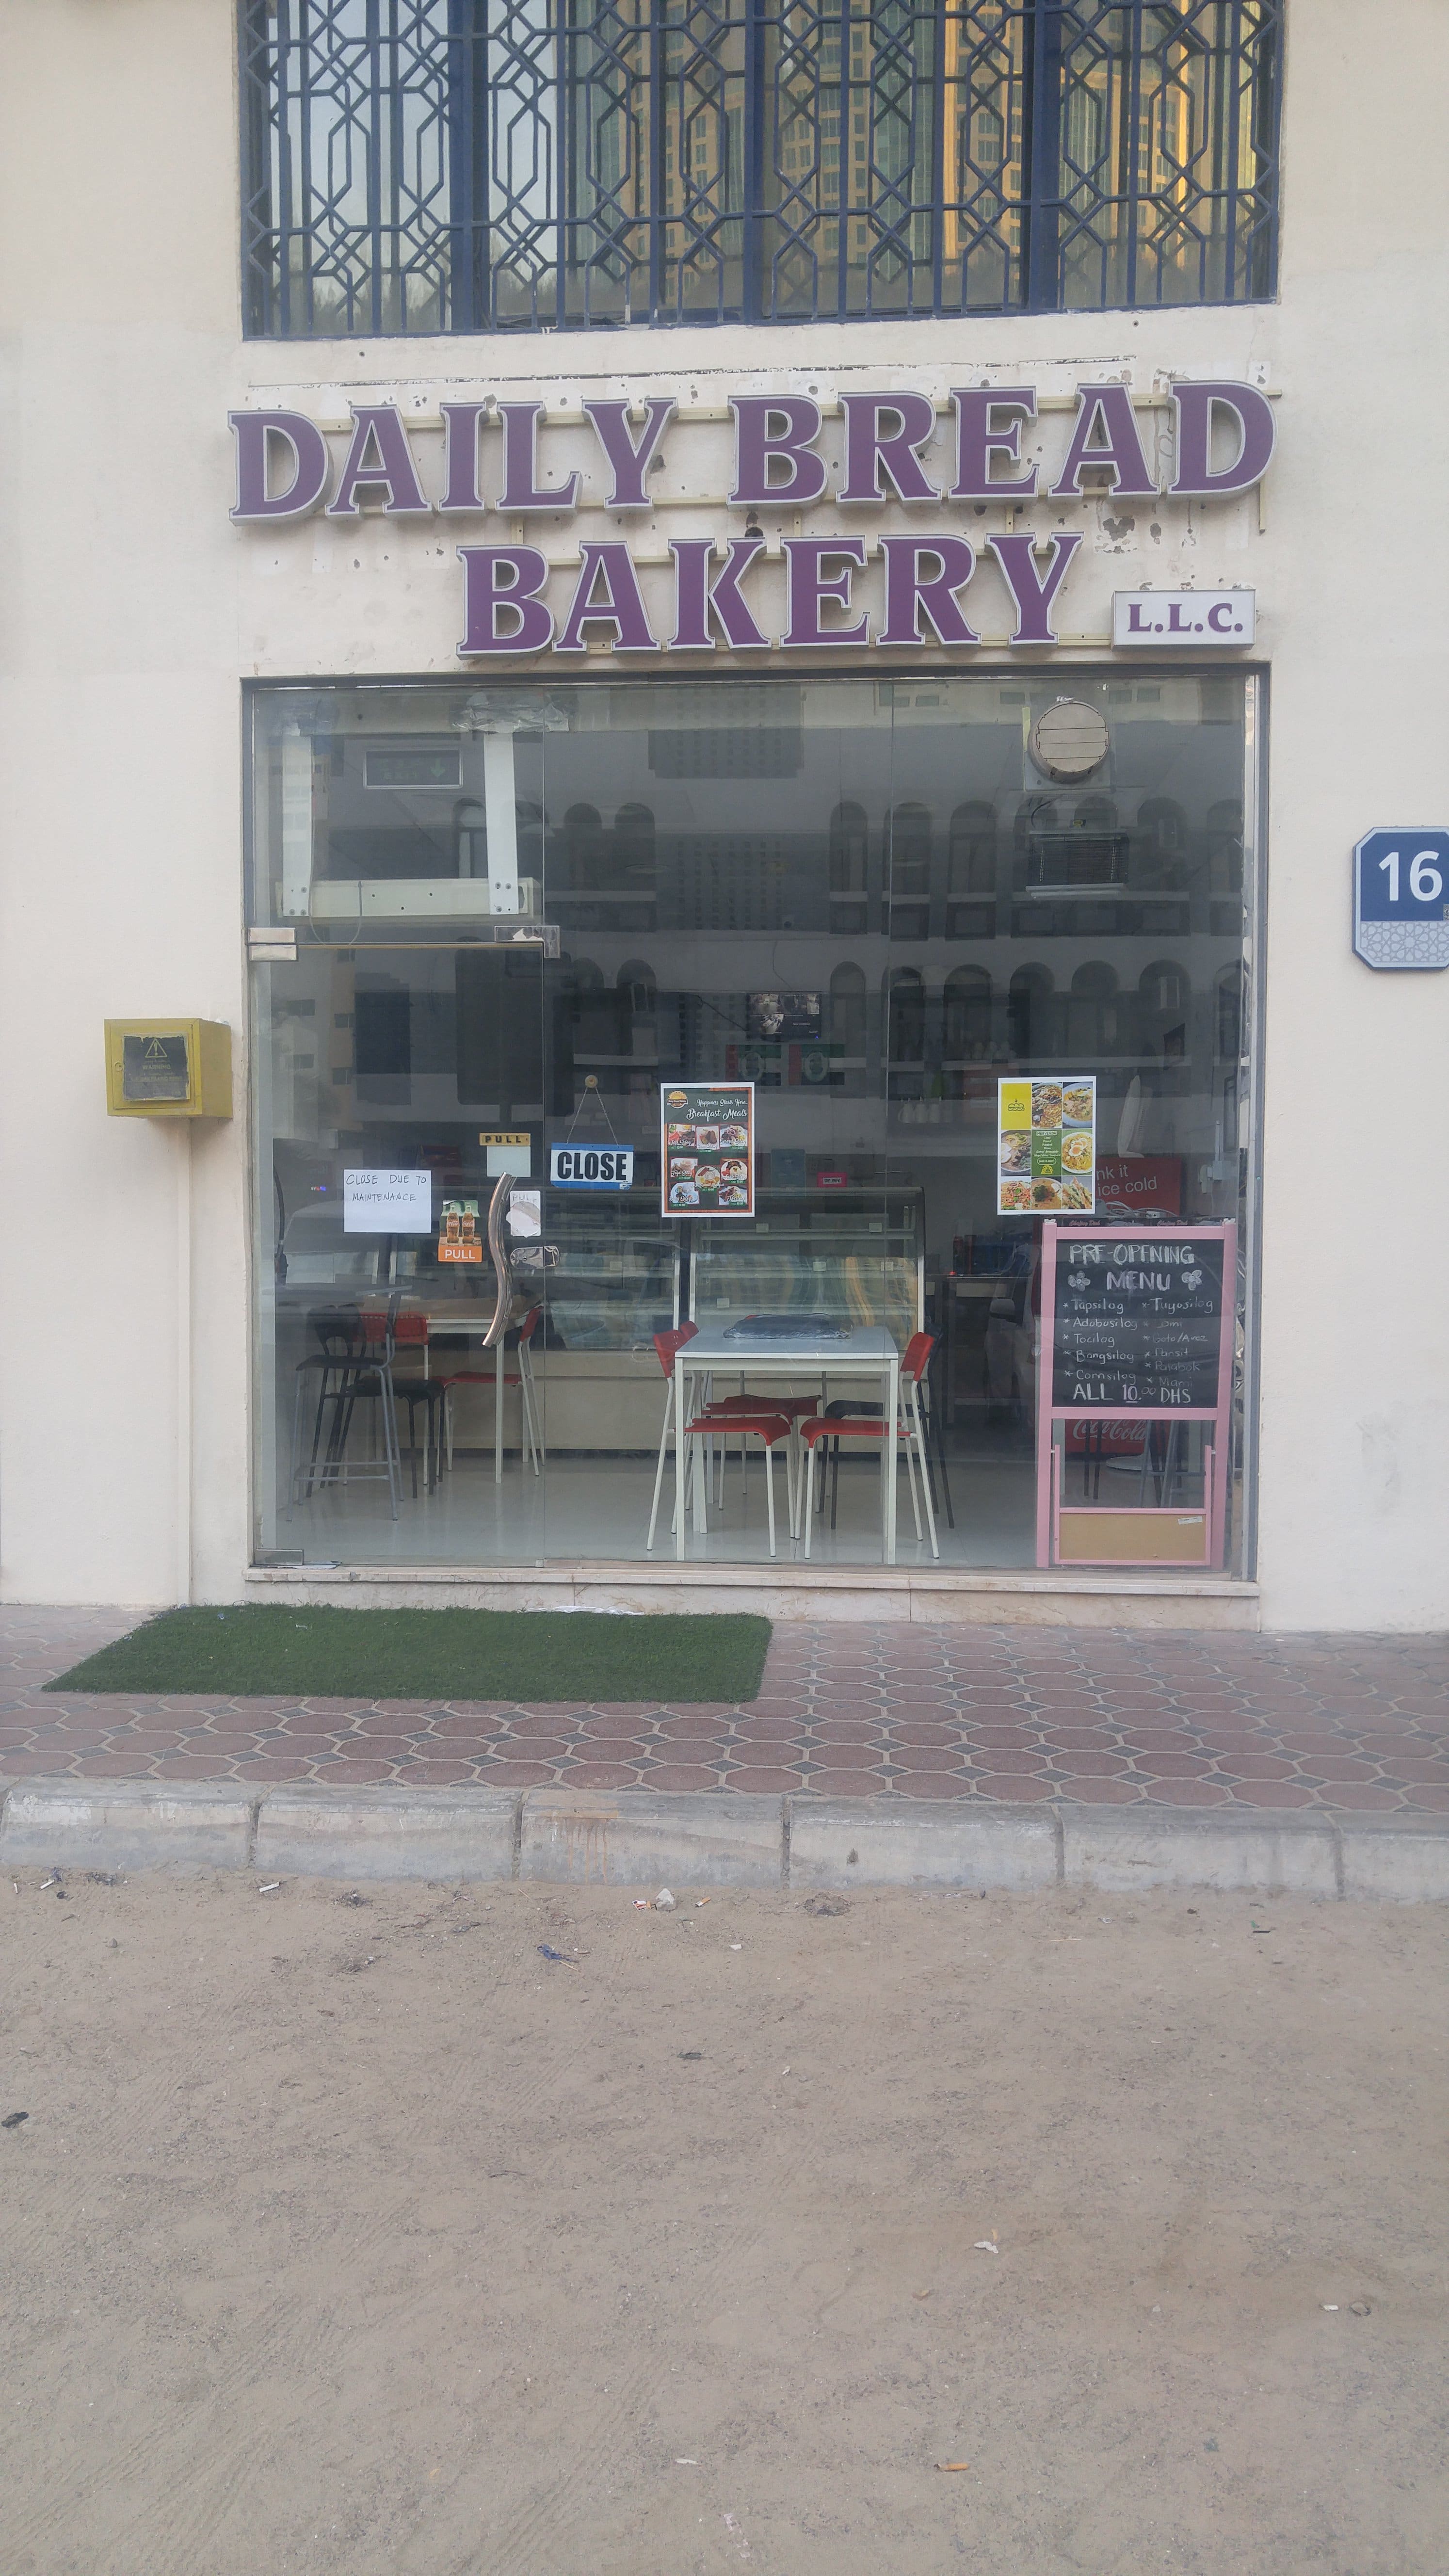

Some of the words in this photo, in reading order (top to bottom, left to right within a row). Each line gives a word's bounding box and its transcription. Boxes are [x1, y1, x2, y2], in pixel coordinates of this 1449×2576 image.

[228, 396, 680, 527] DAILY
[727, 379, 1278, 505] BREAD
[456, 531, 1085, 660] BAKERY
[1127, 602, 1244, 633] L.L.C.
[1378, 850, 1443, 902] 16
[686, 1108, 721, 1122] Breakfast
[723, 1108, 748, 1120] Meals
[557, 1151, 627, 1181] CLOSE
[1119, 1164, 1129, 1178] it
[346, 1175, 378, 1186] CLOSE
[389, 1175, 410, 1185] DUE
[416, 1175, 427, 1185] TO
[1097, 1183, 1120, 1197] ice
[1125, 1176, 1157, 1193] cold
[352, 1191, 417, 1202] MAINTENANCE
[445, 1249, 476, 1259] PULL
[1106, 1270, 1171, 1291] MENU
[1071, 1298, 1124, 1315] Tapsilog
[1149, 1296, 1213, 1315] Tuyosilog
[1073, 1317, 1137, 1331] Adobosilog
[1074, 1332, 1115, 1348] Tocilog
[1076, 1350, 1134, 1364] Bangsilog
[1156, 1348, 1188, 1357] Pansit
[1072, 1383, 1114, 1401] ALL
[1160, 1387, 1191, 1403] DHS
